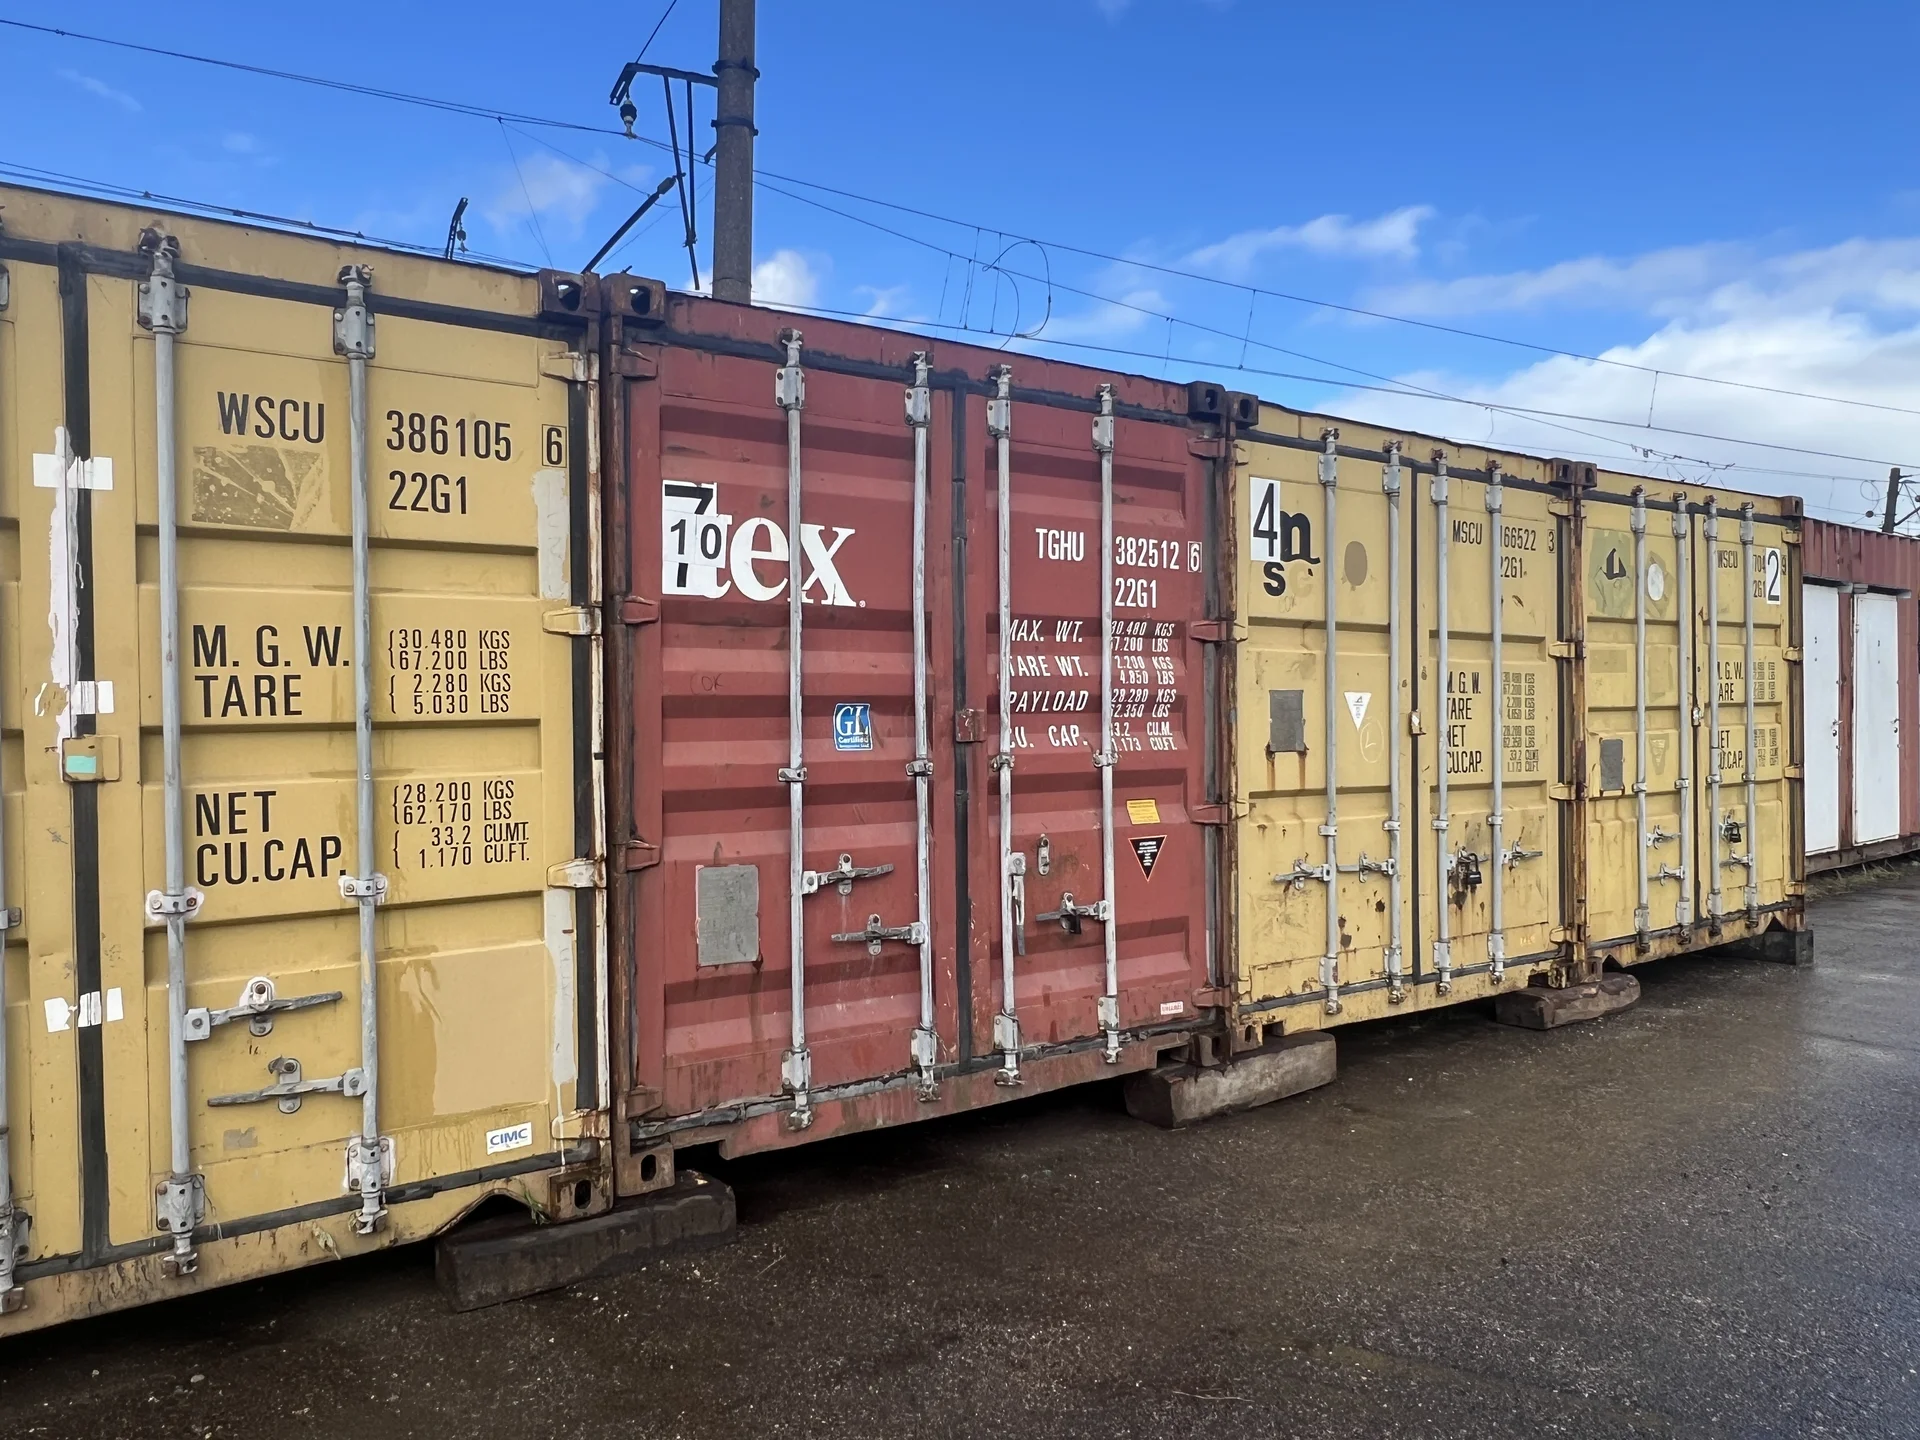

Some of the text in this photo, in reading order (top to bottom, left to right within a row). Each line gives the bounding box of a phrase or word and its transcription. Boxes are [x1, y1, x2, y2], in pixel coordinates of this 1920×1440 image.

[217, 391, 564, 466] WSCU 386105 6
[389, 470, 467, 515] 22G1
[1253, 483, 1278, 557] 4
[670, 519, 722, 559] 10
[1453, 520, 1482, 545] MSCU
[1548, 530, 1555, 552] 3
[1036, 528, 1200, 572] TGHU 382512 6
[1768, 550, 1780, 601] 2
[1114, 578, 1156, 608] 22G1
[399, 629, 510, 650] 30.480 KGS
[1056, 620, 1083, 642] WT.
[1155, 623, 1174, 636] KGS
[193, 625, 350, 667] M. G. W.
[1112, 636, 1168, 652] 7.200 LBS
[399, 651, 508, 670] 67.200 LBS
[1054, 656, 1088, 677] WT.
[1152, 656, 1173, 670] KGS
[414, 673, 511, 694] 2.280 KGS
[1157, 671, 1174, 684] LBS
[1459, 672, 1468, 693] G.
[1472, 672, 1481, 694] W.
[194, 674, 302, 718] TARE
[1156, 689, 1176, 702] KGS
[1718, 683, 1734, 701] ARE
[414, 694, 510, 715] 5.030 LBS
[1152, 704, 1170, 717] LBS
[836, 706, 868, 736] GL
[1048, 725, 1088, 747] CAP.
[403, 780, 514, 804] 28.200 KGS
[196, 790, 277, 837] NET
[403, 802, 512, 824] 62.170 LBS
[432, 825, 472, 846] 33.2
[196, 836, 347, 887] CU.CAP.
[418, 842, 530, 869] 1.170 CU.FT.
[490, 1128, 528, 1145] CIMC
